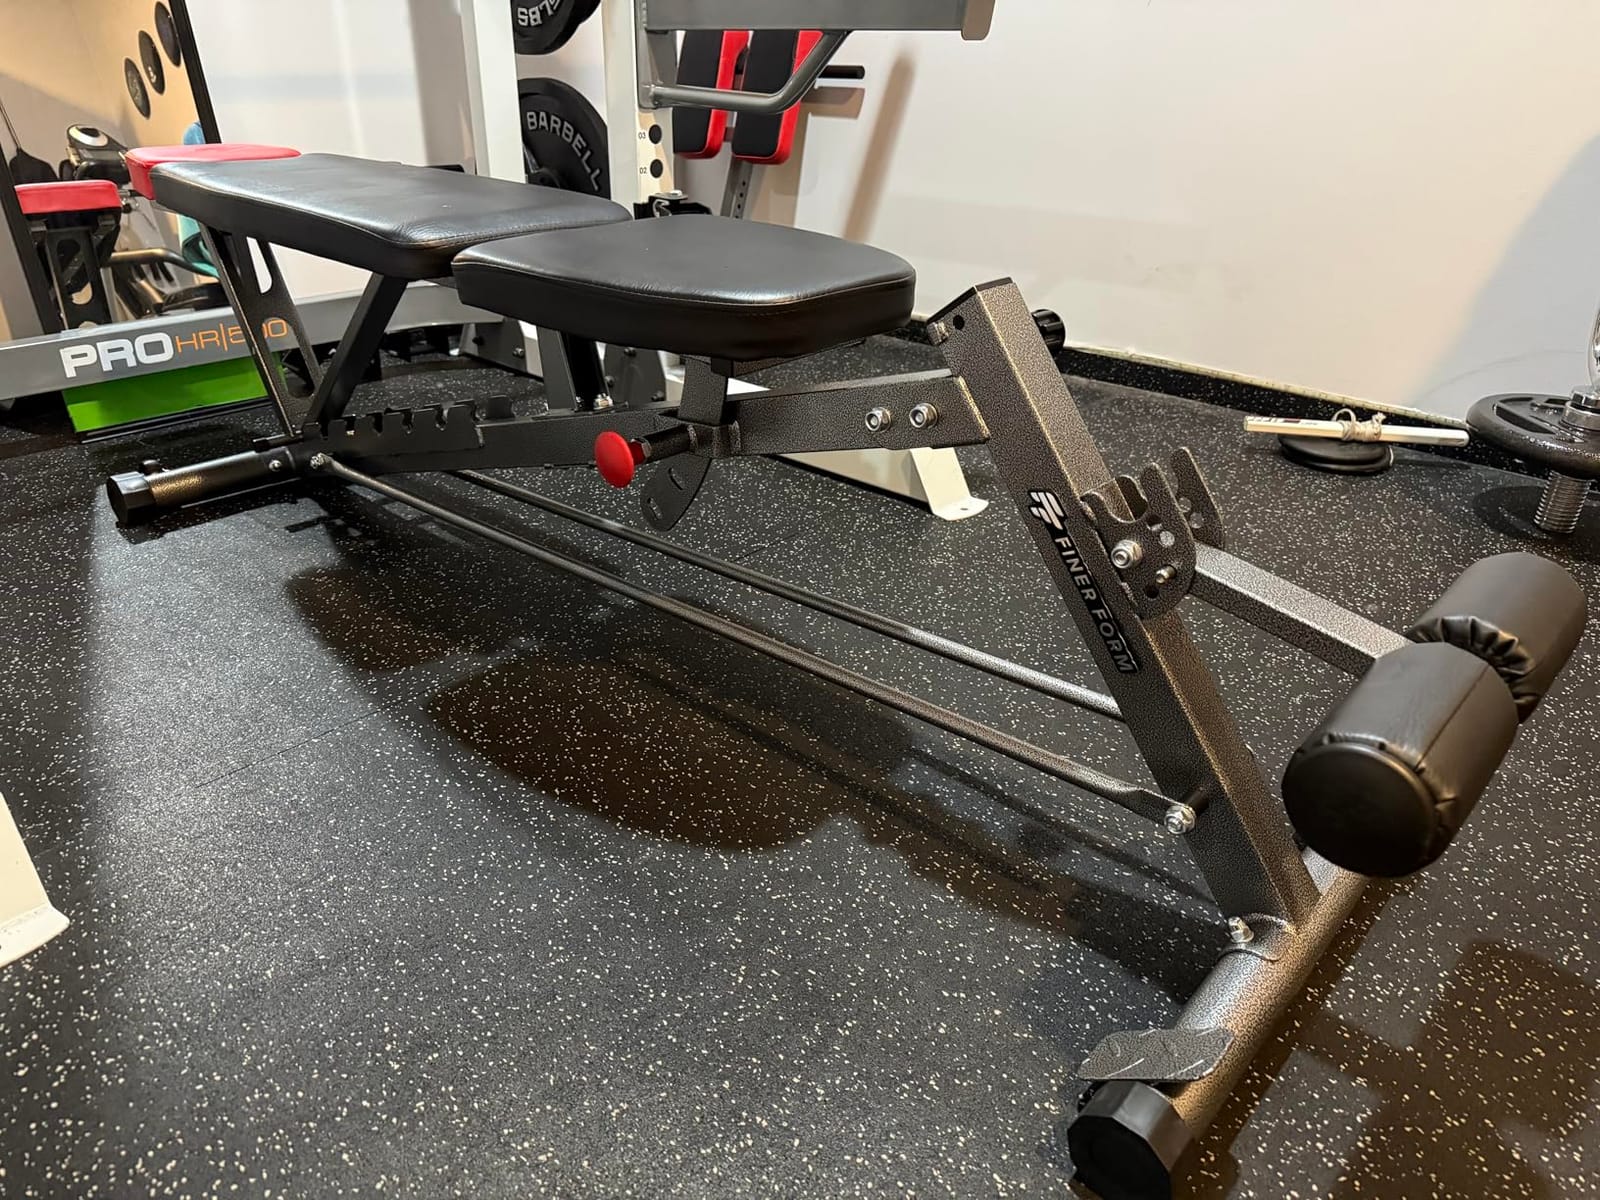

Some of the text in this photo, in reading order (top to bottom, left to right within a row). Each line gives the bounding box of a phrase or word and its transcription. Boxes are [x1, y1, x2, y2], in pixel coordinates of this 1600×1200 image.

[526, 111, 601, 191] BARBELL
[638, 132, 646, 140] 03
[59, 332, 175, 378] PRO
[1054, 536, 1134, 672] FINER FORM
